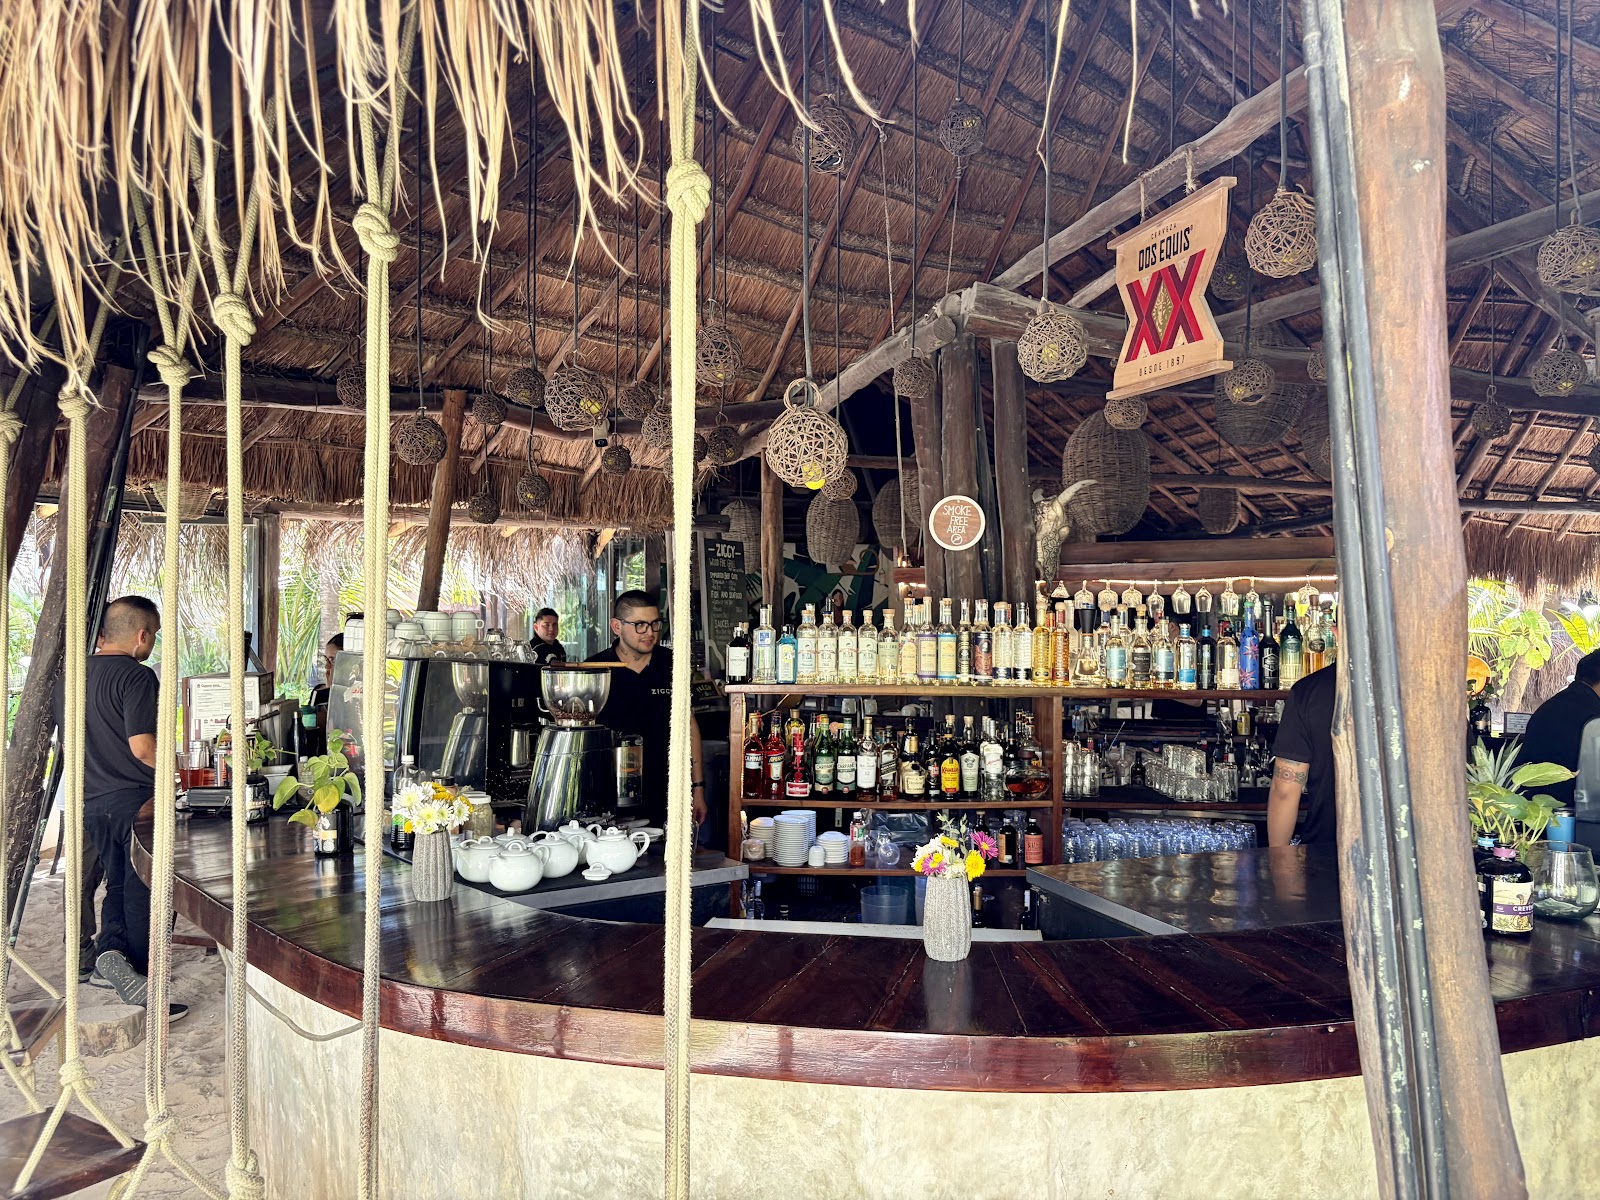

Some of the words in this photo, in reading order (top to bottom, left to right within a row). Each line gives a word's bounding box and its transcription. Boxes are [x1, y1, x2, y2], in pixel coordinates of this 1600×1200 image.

[1151, 223, 1177, 240] CERVEZA
[1138, 243, 1157, 272] DOS
[1159, 226, 1191, 263] EQUIS
[1124, 248, 1206, 363] XX
[1138, 361, 1162, 377] DESDE
[942, 504, 972, 517] SMOKE
[949, 515, 969, 526] FREE
[946, 524, 966, 534] AREA
[715, 543, 736, 559] ZIGGY
[720, 591, 728, 599] AND
